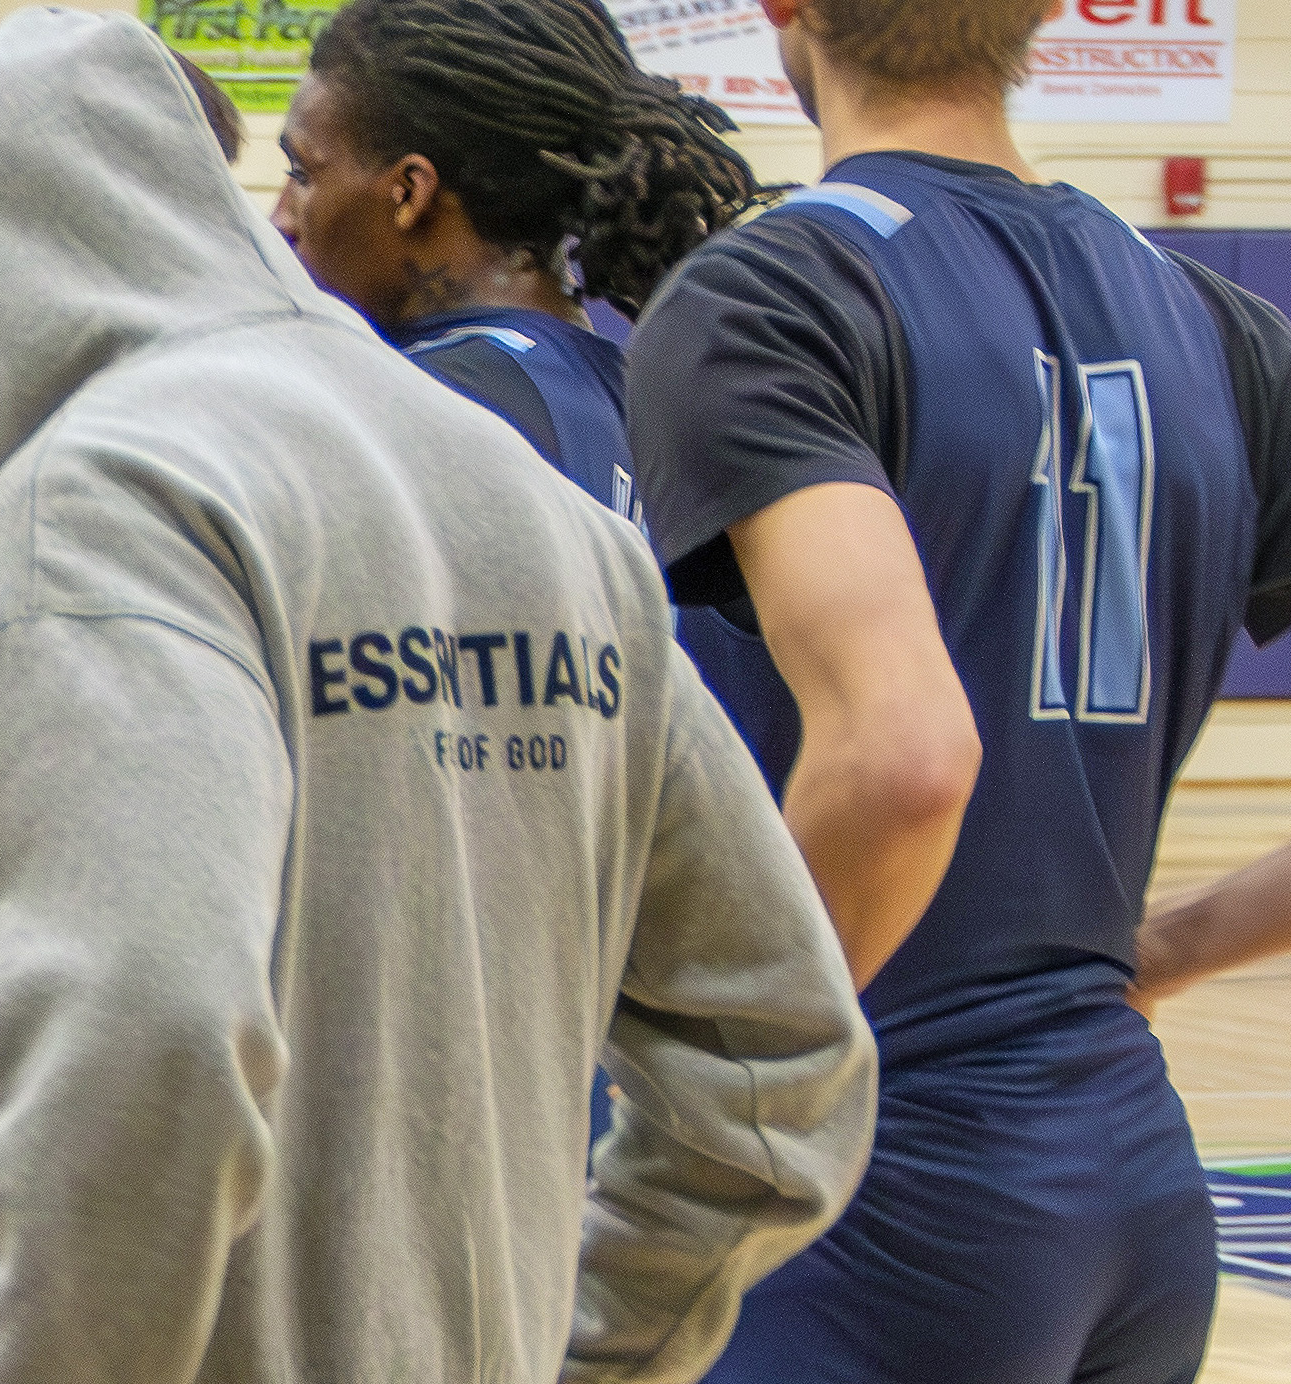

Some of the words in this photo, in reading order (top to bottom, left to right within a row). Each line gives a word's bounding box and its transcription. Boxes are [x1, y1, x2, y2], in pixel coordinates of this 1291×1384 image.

[1029, 46, 1217, 70] NSTRUCTION
[1028, 346, 1155, 725] 11
[456, 733, 490, 772] OF
[505, 733, 567, 772] GOD
